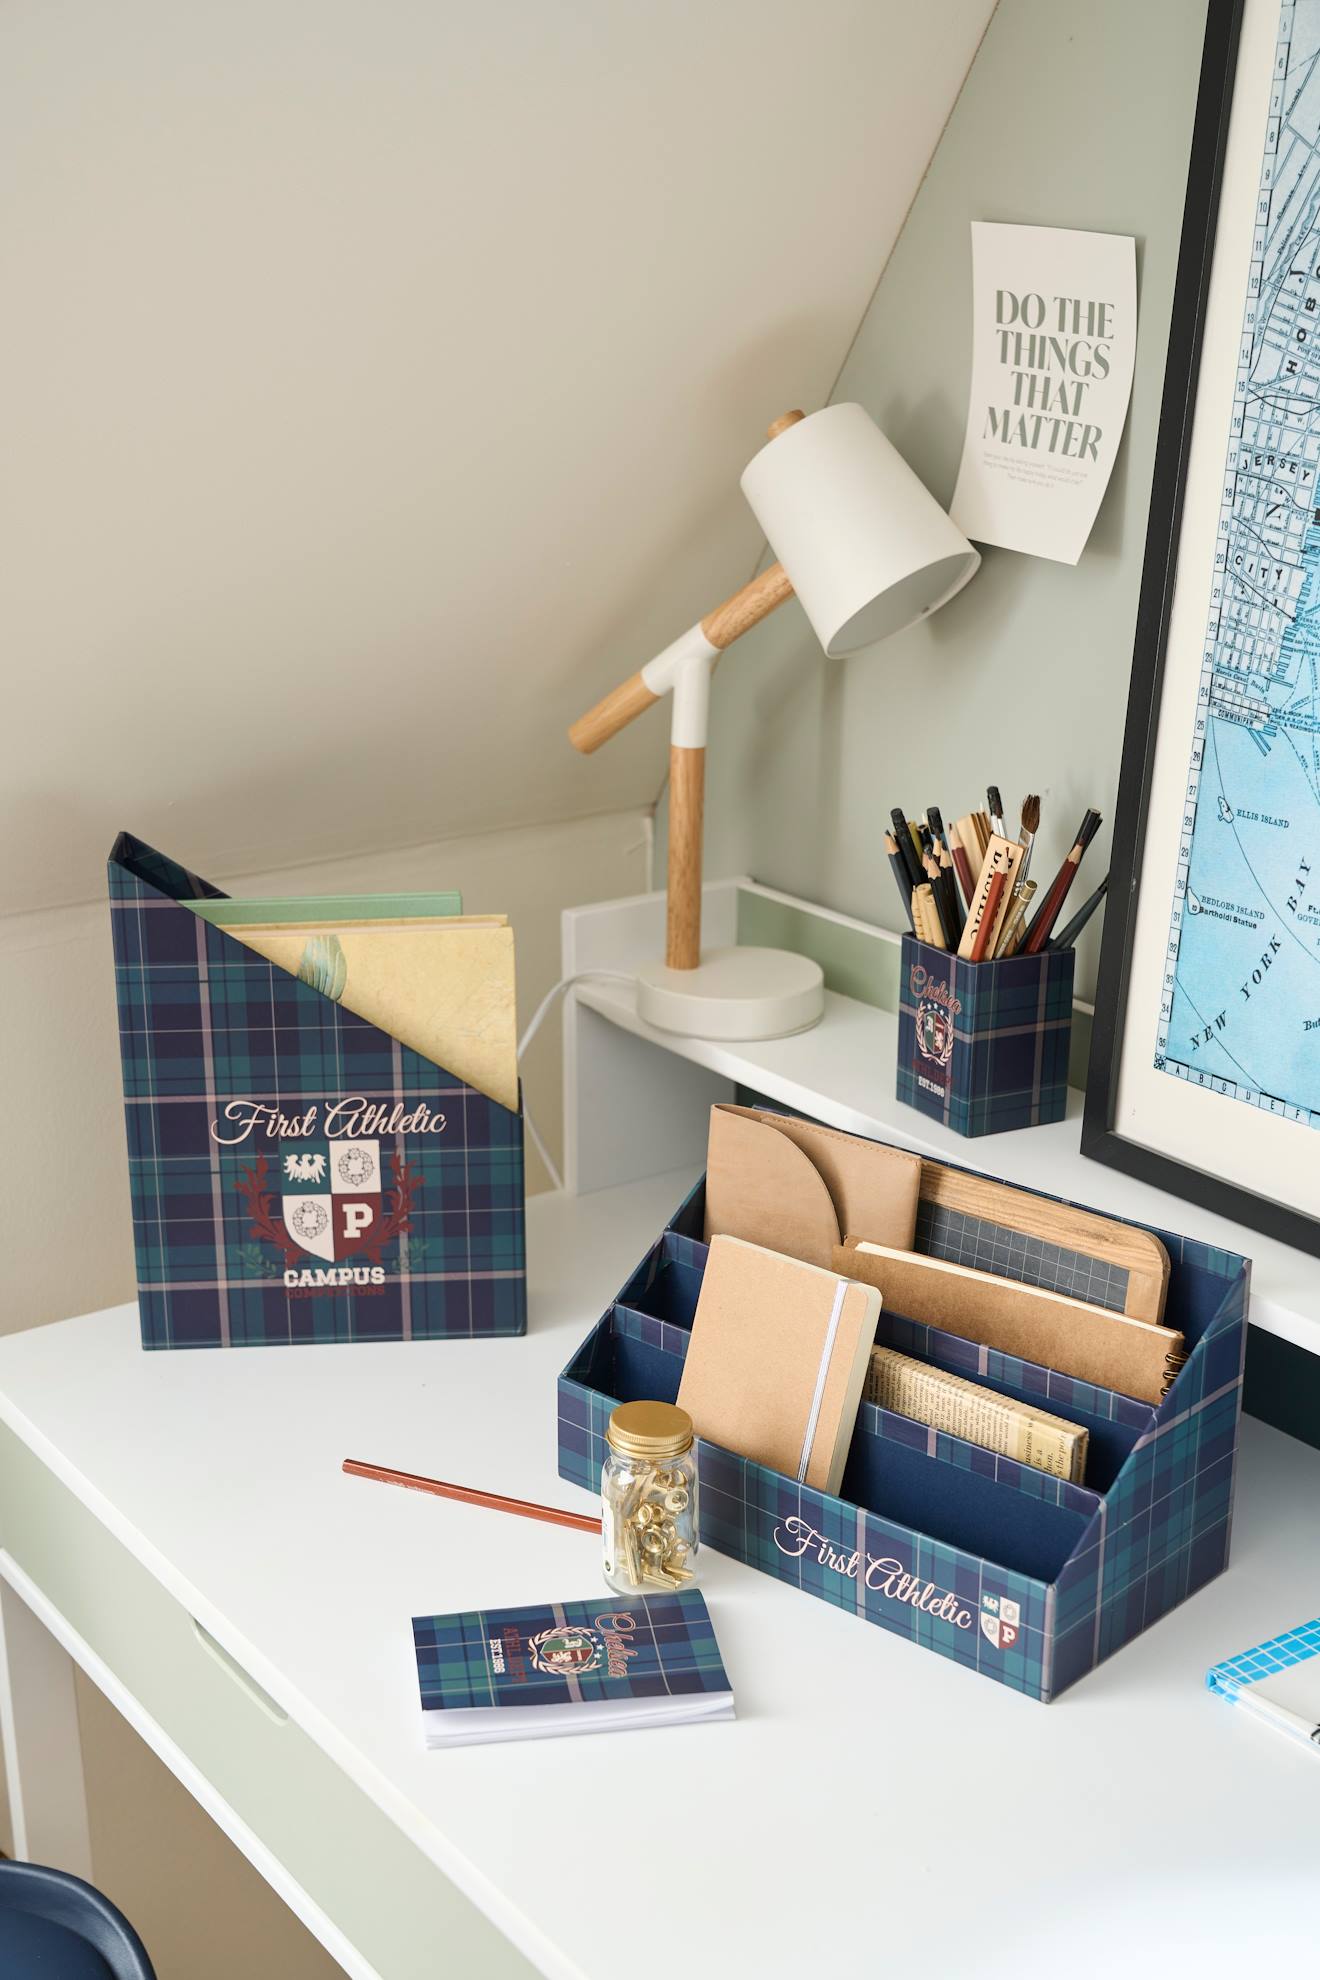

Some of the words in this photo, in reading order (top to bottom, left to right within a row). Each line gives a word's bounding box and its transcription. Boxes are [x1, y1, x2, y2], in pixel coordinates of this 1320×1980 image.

[1278, 58, 1284, 68] 6
[1274, 96, 1279, 108] 7
[1270, 131, 1275, 142] 8
[1265, 169, 1270, 180] 9
[1260, 202, 1268, 213] 10
[1256, 240, 1262, 252] 11
[1252, 278, 1258, 288] 12
[996, 289, 1046, 330] DO
[1053, 296, 1116, 340] THE
[996, 328, 1111, 380] THINGS
[1242, 349, 1248, 360] 14
[1238, 382, 1246, 392] 15
[1010, 371, 1090, 417] THAT
[1234, 418, 1241, 428] 16
[982, 406, 1104, 464] MATTER
[1229, 452, 1236, 464] 17
[1243, 454, 1310, 481] JERSEY
[1225, 488, 1232, 498] 18
[1221, 520, 1228, 532] 19
[1216, 554, 1224, 564] 20
[1235, 555, 1283, 580] CITY
[1213, 588, 1220, 598] 21
[1208, 622, 1216, 632] 22
[1204, 652, 1212, 663] 23
[1200, 688, 1208, 697] 24
[1196, 720, 1204, 730] 25
[1192, 752, 1200, 762] 26
[1188, 785, 1196, 796] 27
[1184, 816, 1192, 826] 28
[1236, 808, 1259, 822] ELLIS
[1261, 814, 1290, 829] ISLAND
[1181, 847, 1188, 858] 29
[1177, 880, 1185, 890] 30
[1173, 912, 1180, 922] 31
[1200, 906, 1233, 922] Bartholdi
[1233, 915, 1257, 929] Statue
[1236, 904, 1265, 920] ISLAND
[1169, 942, 1177, 954] 32
[1189, 1009, 1227, 1051] NEW
[1240, 933, 1282, 1001] YORK
[1286, 856, 1311, 914] BAY
[1166, 974, 1174, 984] 33
[1162, 1002, 1170, 1013] 34
[1158, 1037, 1166, 1048] 35
[210, 1100, 318, 1145] First
[324, 1096, 448, 1139] Athletic
[342, 1203, 374, 1238] P
[283, 1266, 386, 1288] CAMPUS
[773, 1516, 862, 1578] First
[865, 1552, 972, 1630] Athletic
[1001, 1625, 1016, 1643] P
